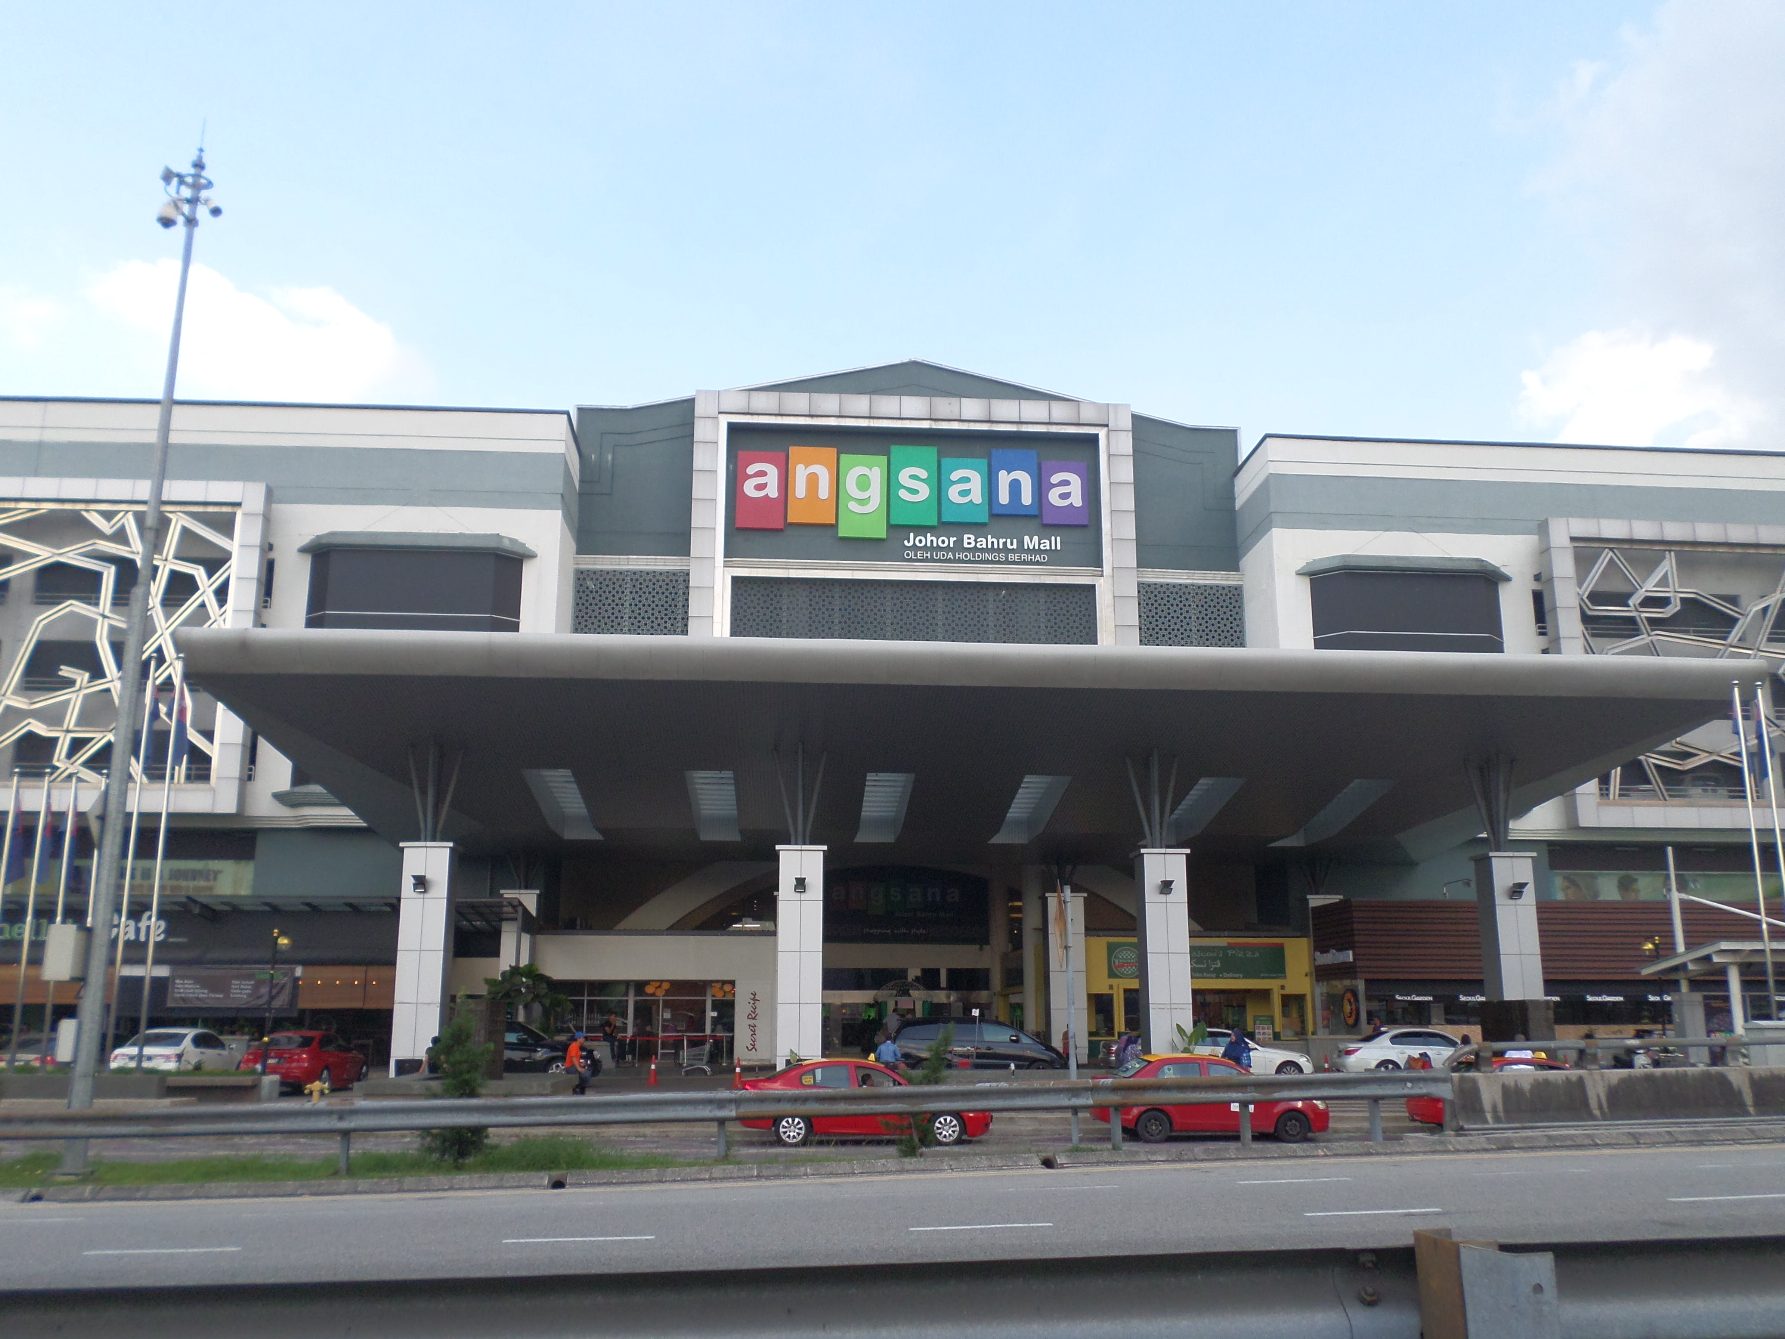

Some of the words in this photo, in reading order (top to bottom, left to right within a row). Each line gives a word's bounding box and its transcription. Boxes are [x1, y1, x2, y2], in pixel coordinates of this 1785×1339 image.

[743, 462, 1083, 514] angsana
[903, 532, 957, 548] Johor
[963, 533, 1017, 550] Bahru
[1023, 535, 1061, 551] Mall
[903, 550, 931, 560] OLEH
[933, 551, 954, 560] UDA
[955, 551, 1005, 562] HOLDINGS
[1008, 553, 1048, 563] BERHAD
[831, 886, 960, 905] angsana
[746, 990, 760, 1020] Recipe
[746, 1022, 758, 1052] Secret
